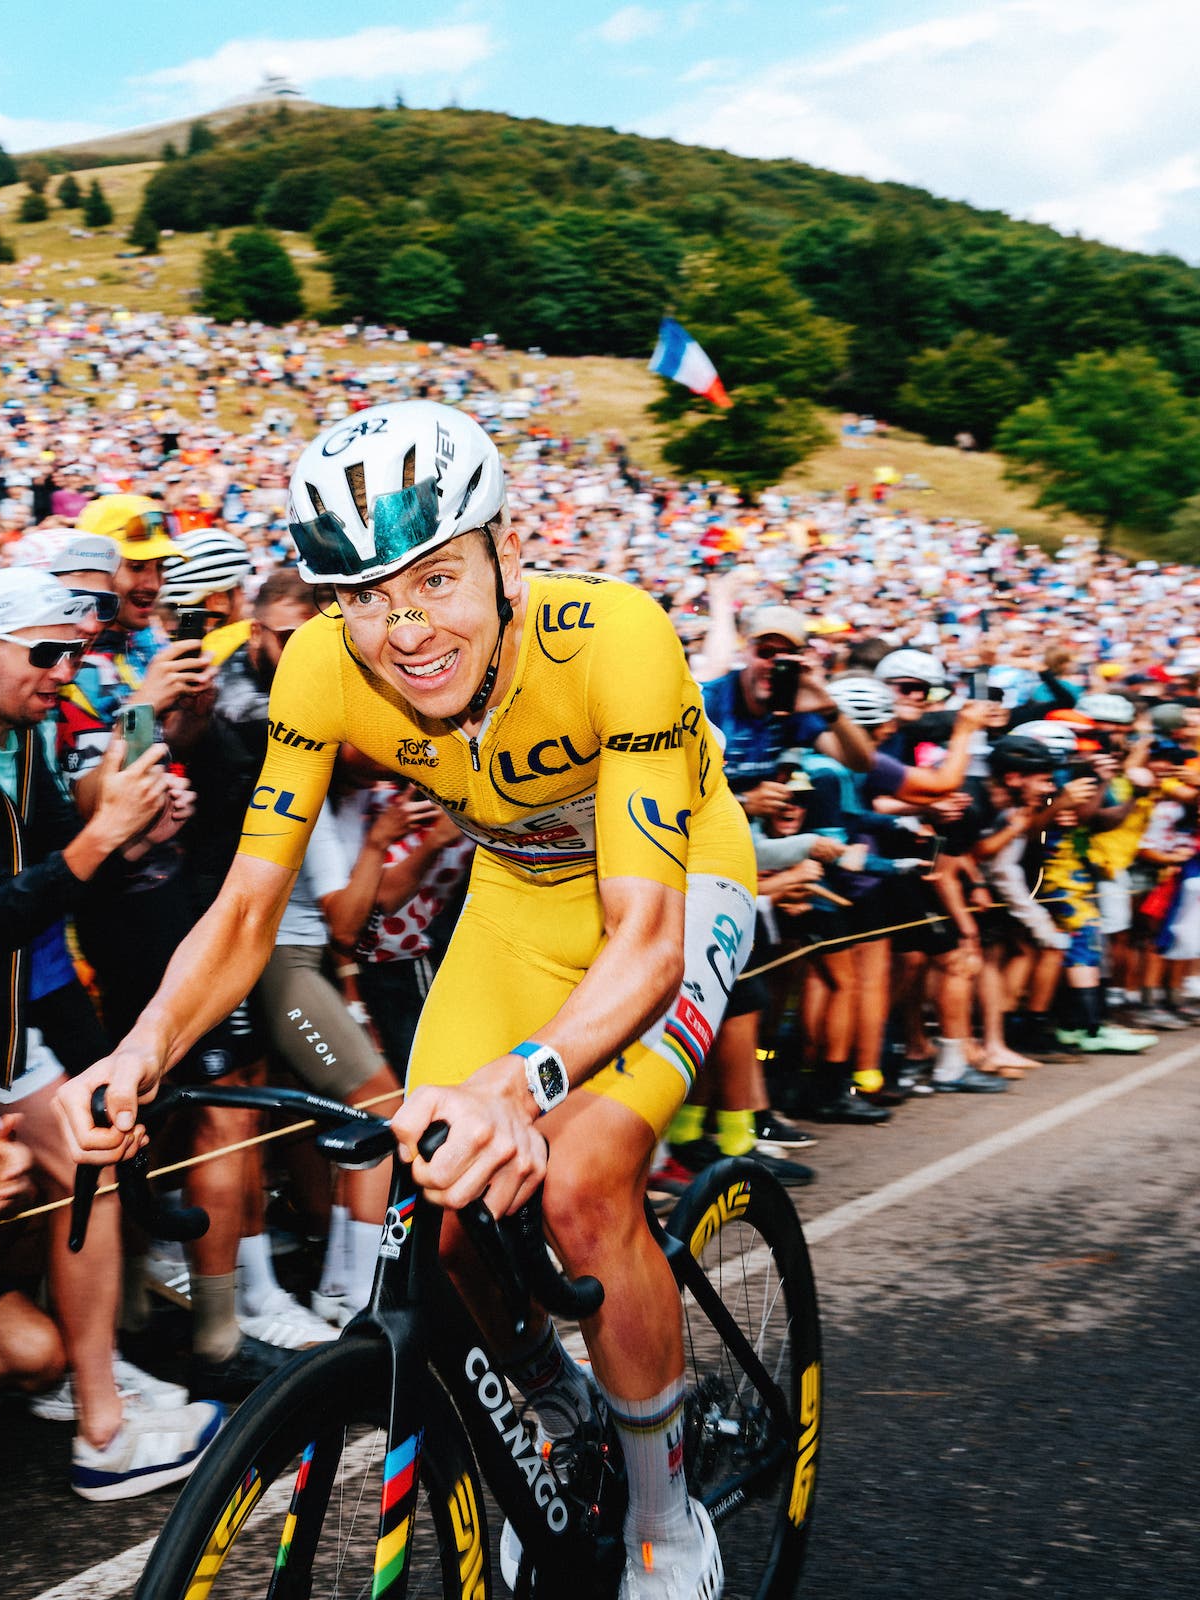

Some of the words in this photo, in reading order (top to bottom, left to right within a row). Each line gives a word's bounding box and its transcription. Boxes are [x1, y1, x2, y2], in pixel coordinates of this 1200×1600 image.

[322, 417, 388, 457] G42
[435, 421, 455, 498] MET
[543, 602, 595, 633] LCL
[498, 735, 600, 784] LCL
[287, 1007, 337, 1066] RYZON
[464, 1346, 569, 1533] COLNAGO
[708, 1487, 746, 1522] Emirates
